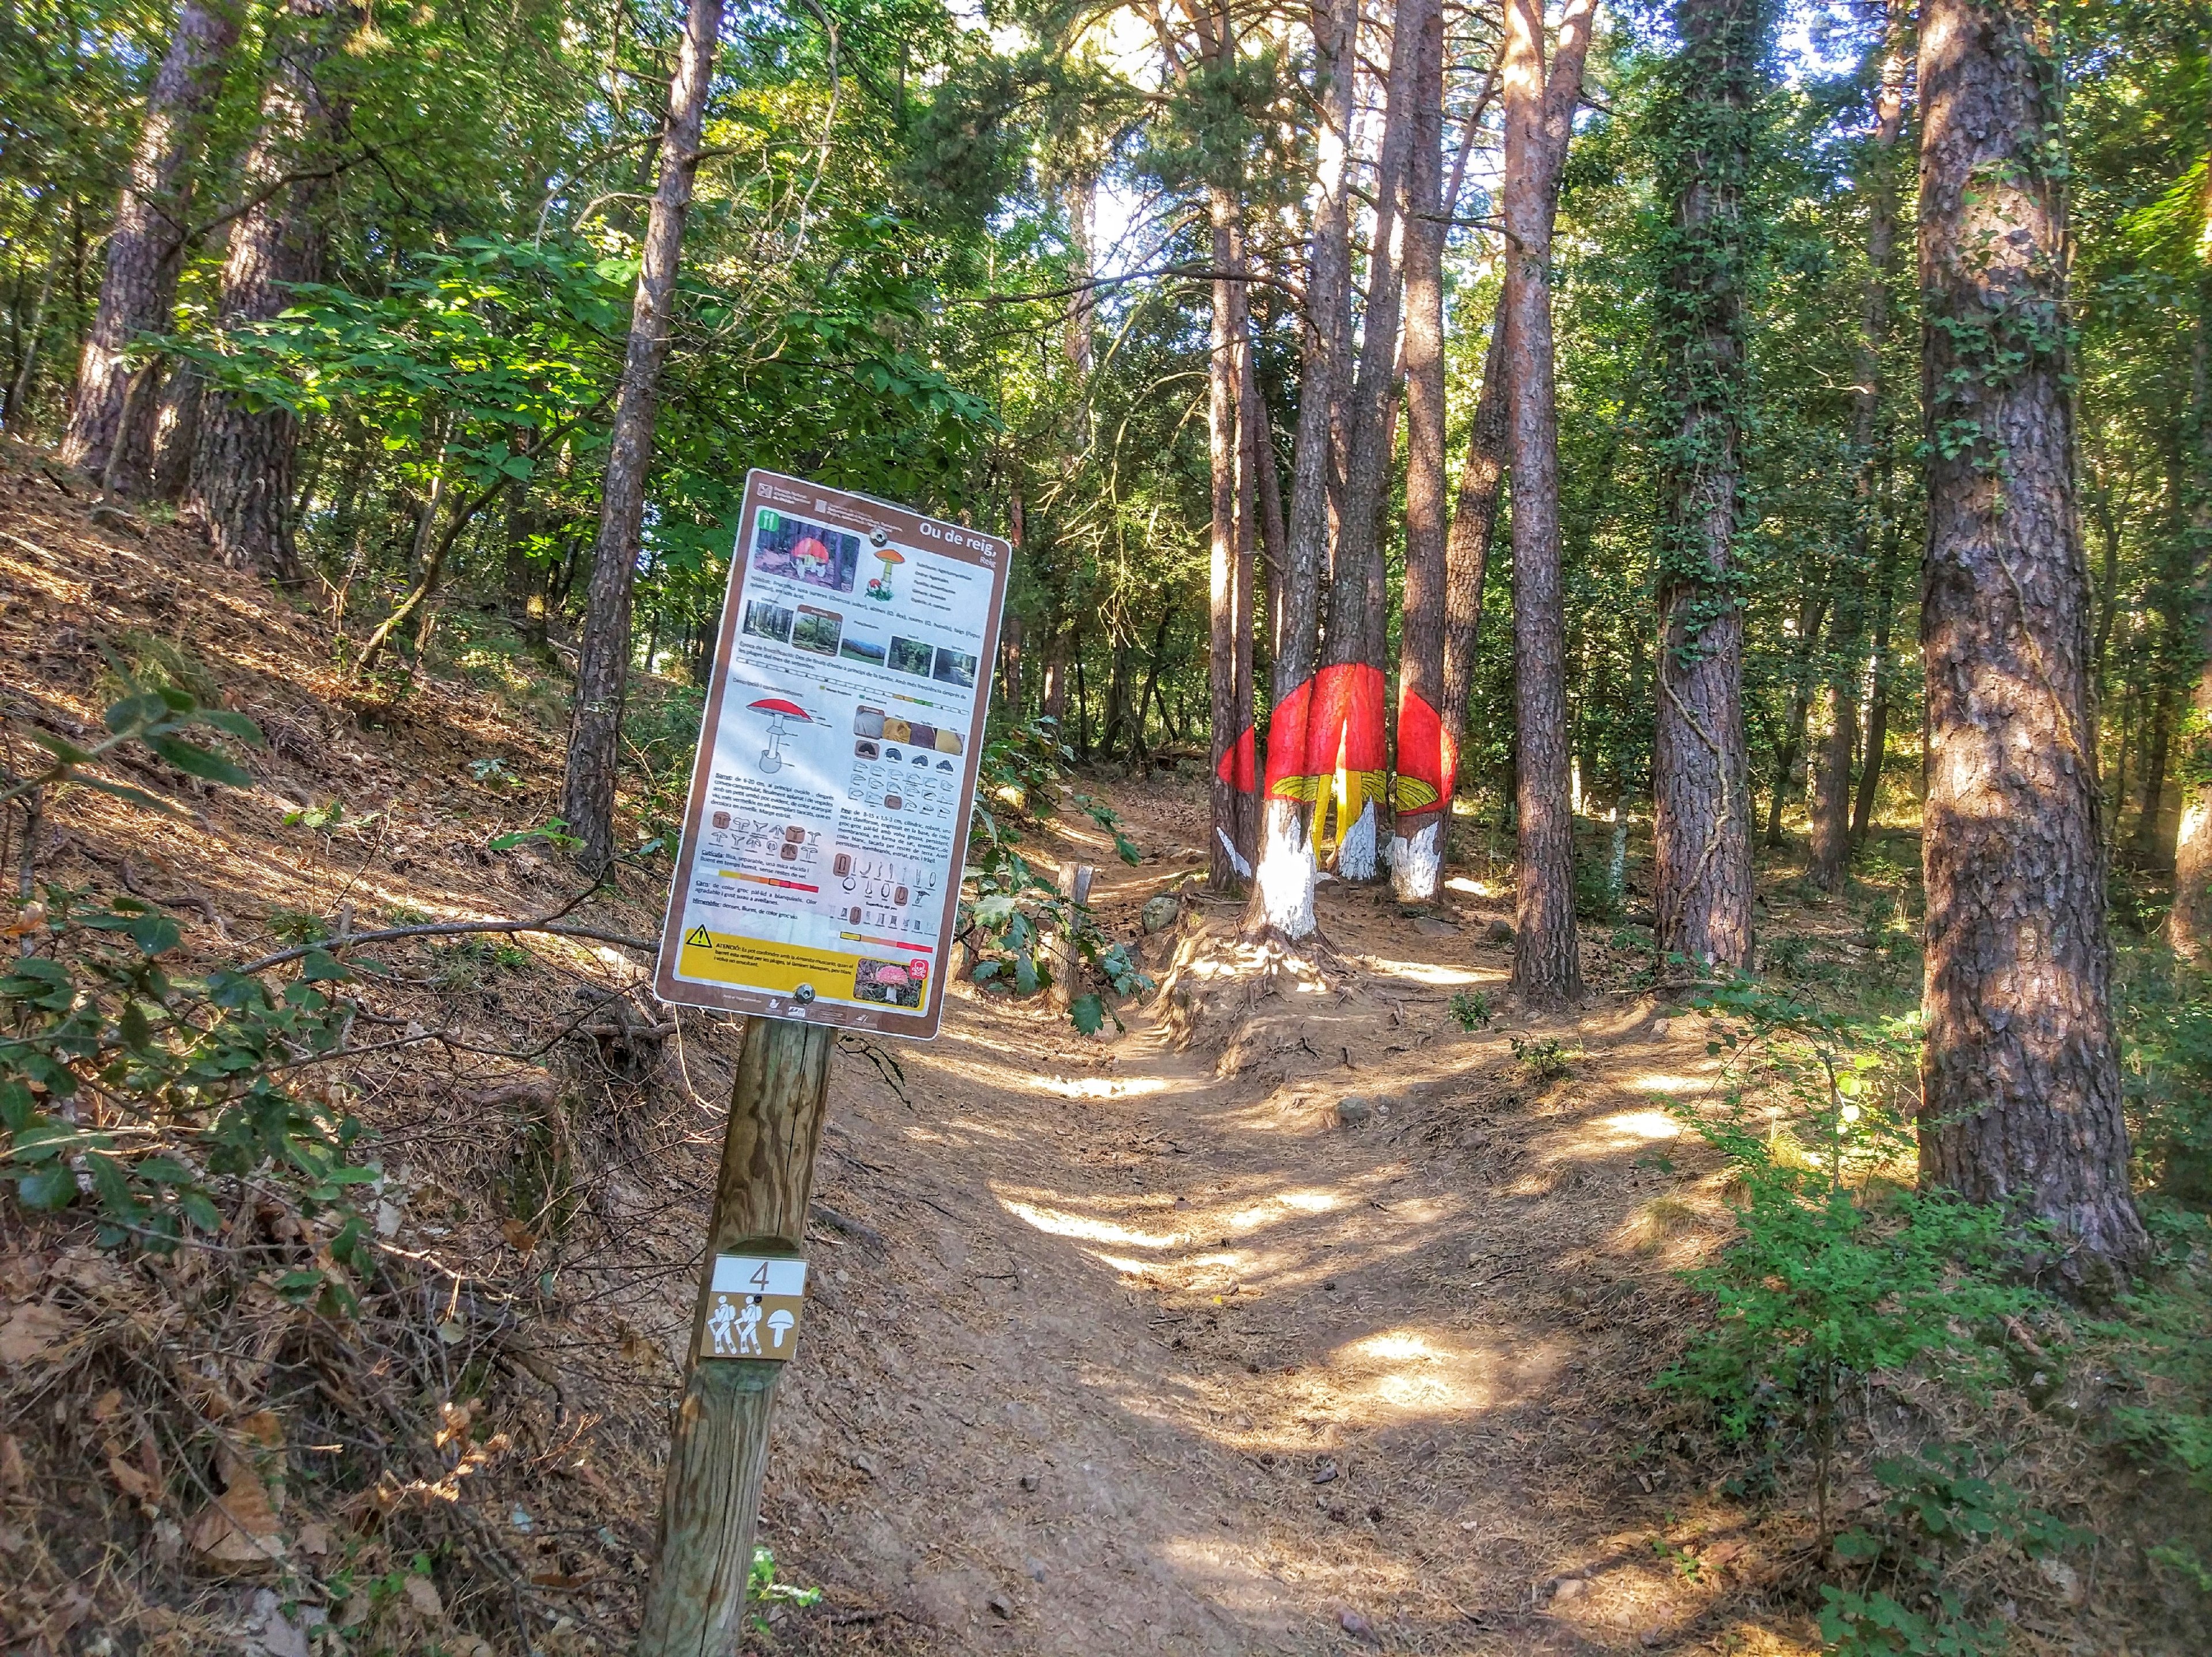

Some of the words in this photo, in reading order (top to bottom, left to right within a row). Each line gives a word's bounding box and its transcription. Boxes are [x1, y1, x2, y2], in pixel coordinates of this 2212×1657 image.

[919, 522, 941, 539] Ou
[944, 529, 963, 544] de
[965, 537, 997, 557] reig,
[979, 556, 996, 568] Reig
[749, 1261, 770, 1291] 4
